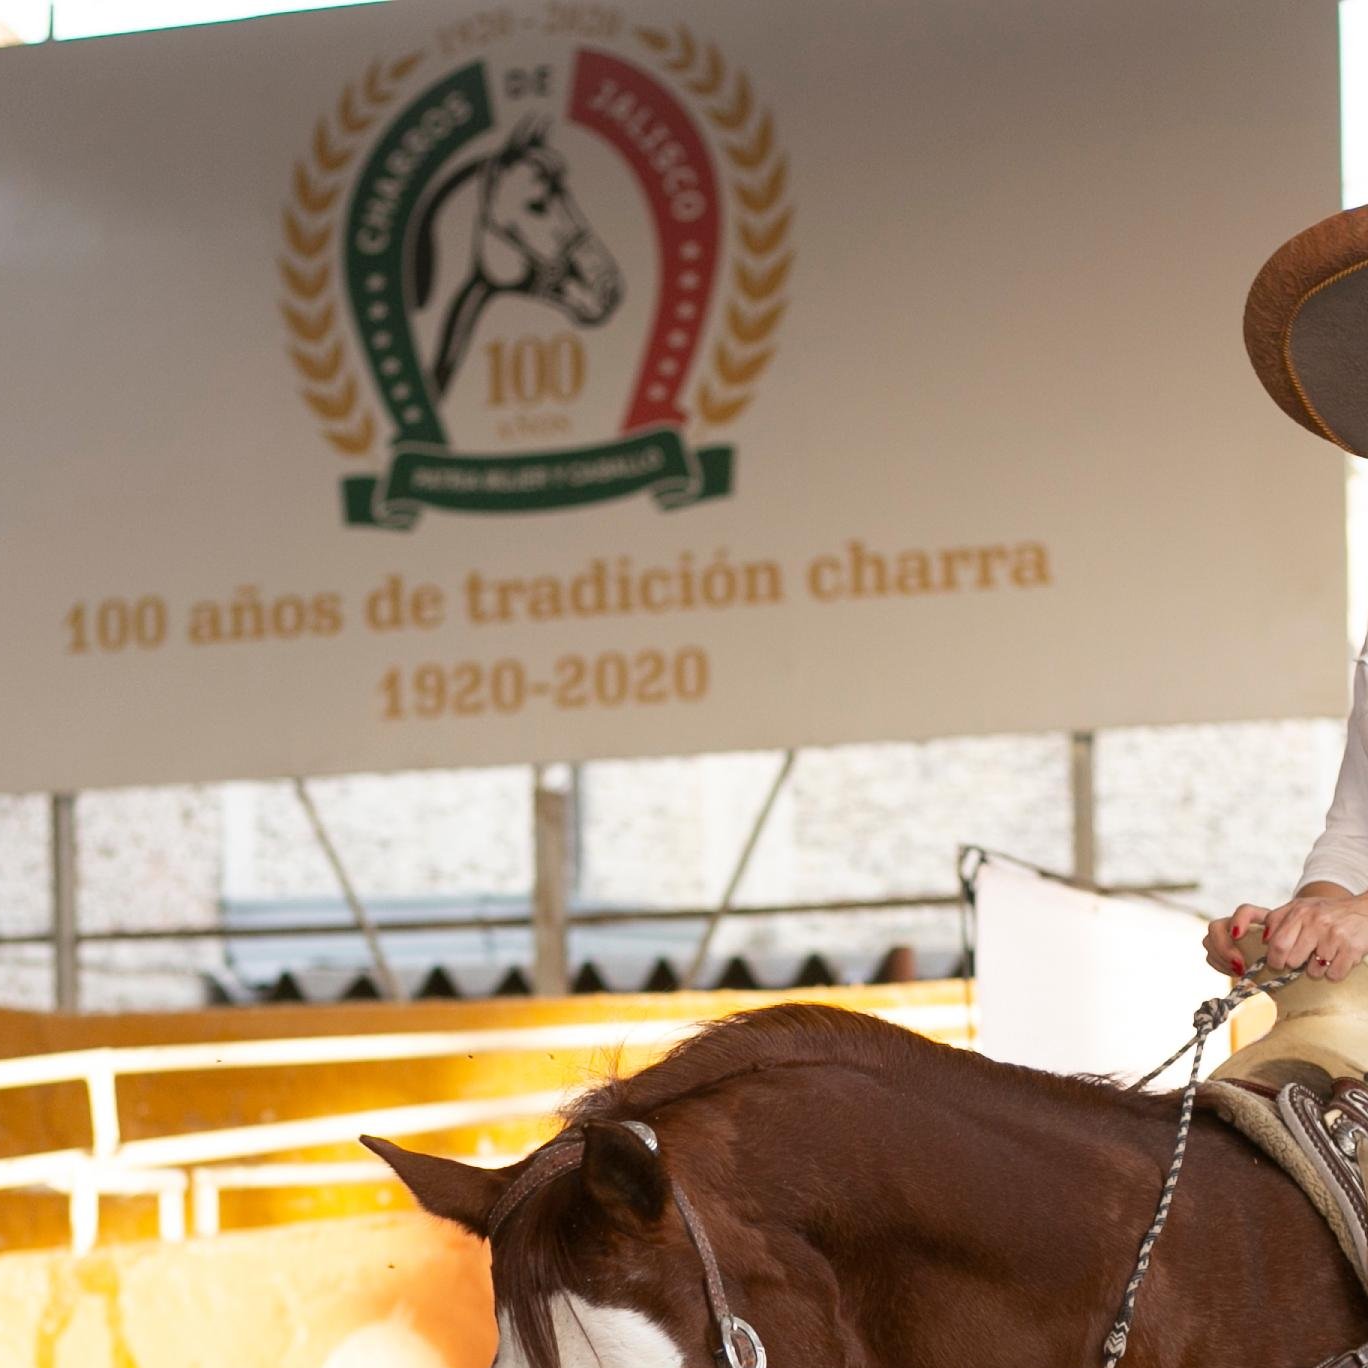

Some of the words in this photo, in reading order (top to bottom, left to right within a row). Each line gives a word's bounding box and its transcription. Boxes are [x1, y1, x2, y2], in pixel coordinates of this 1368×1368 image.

[355, 89, 473, 256] CHARROS
[588, 79, 707, 224] JALISCO
[483, 332, 588, 409] 100
[65, 598, 168, 655] 100
[187, 585, 344, 646] años
[364, 574, 441, 633] de
[463, 548, 787, 626] tradición
[804, 538, 1056, 606] charra
[378, 646, 712, 722] 1920-2020
